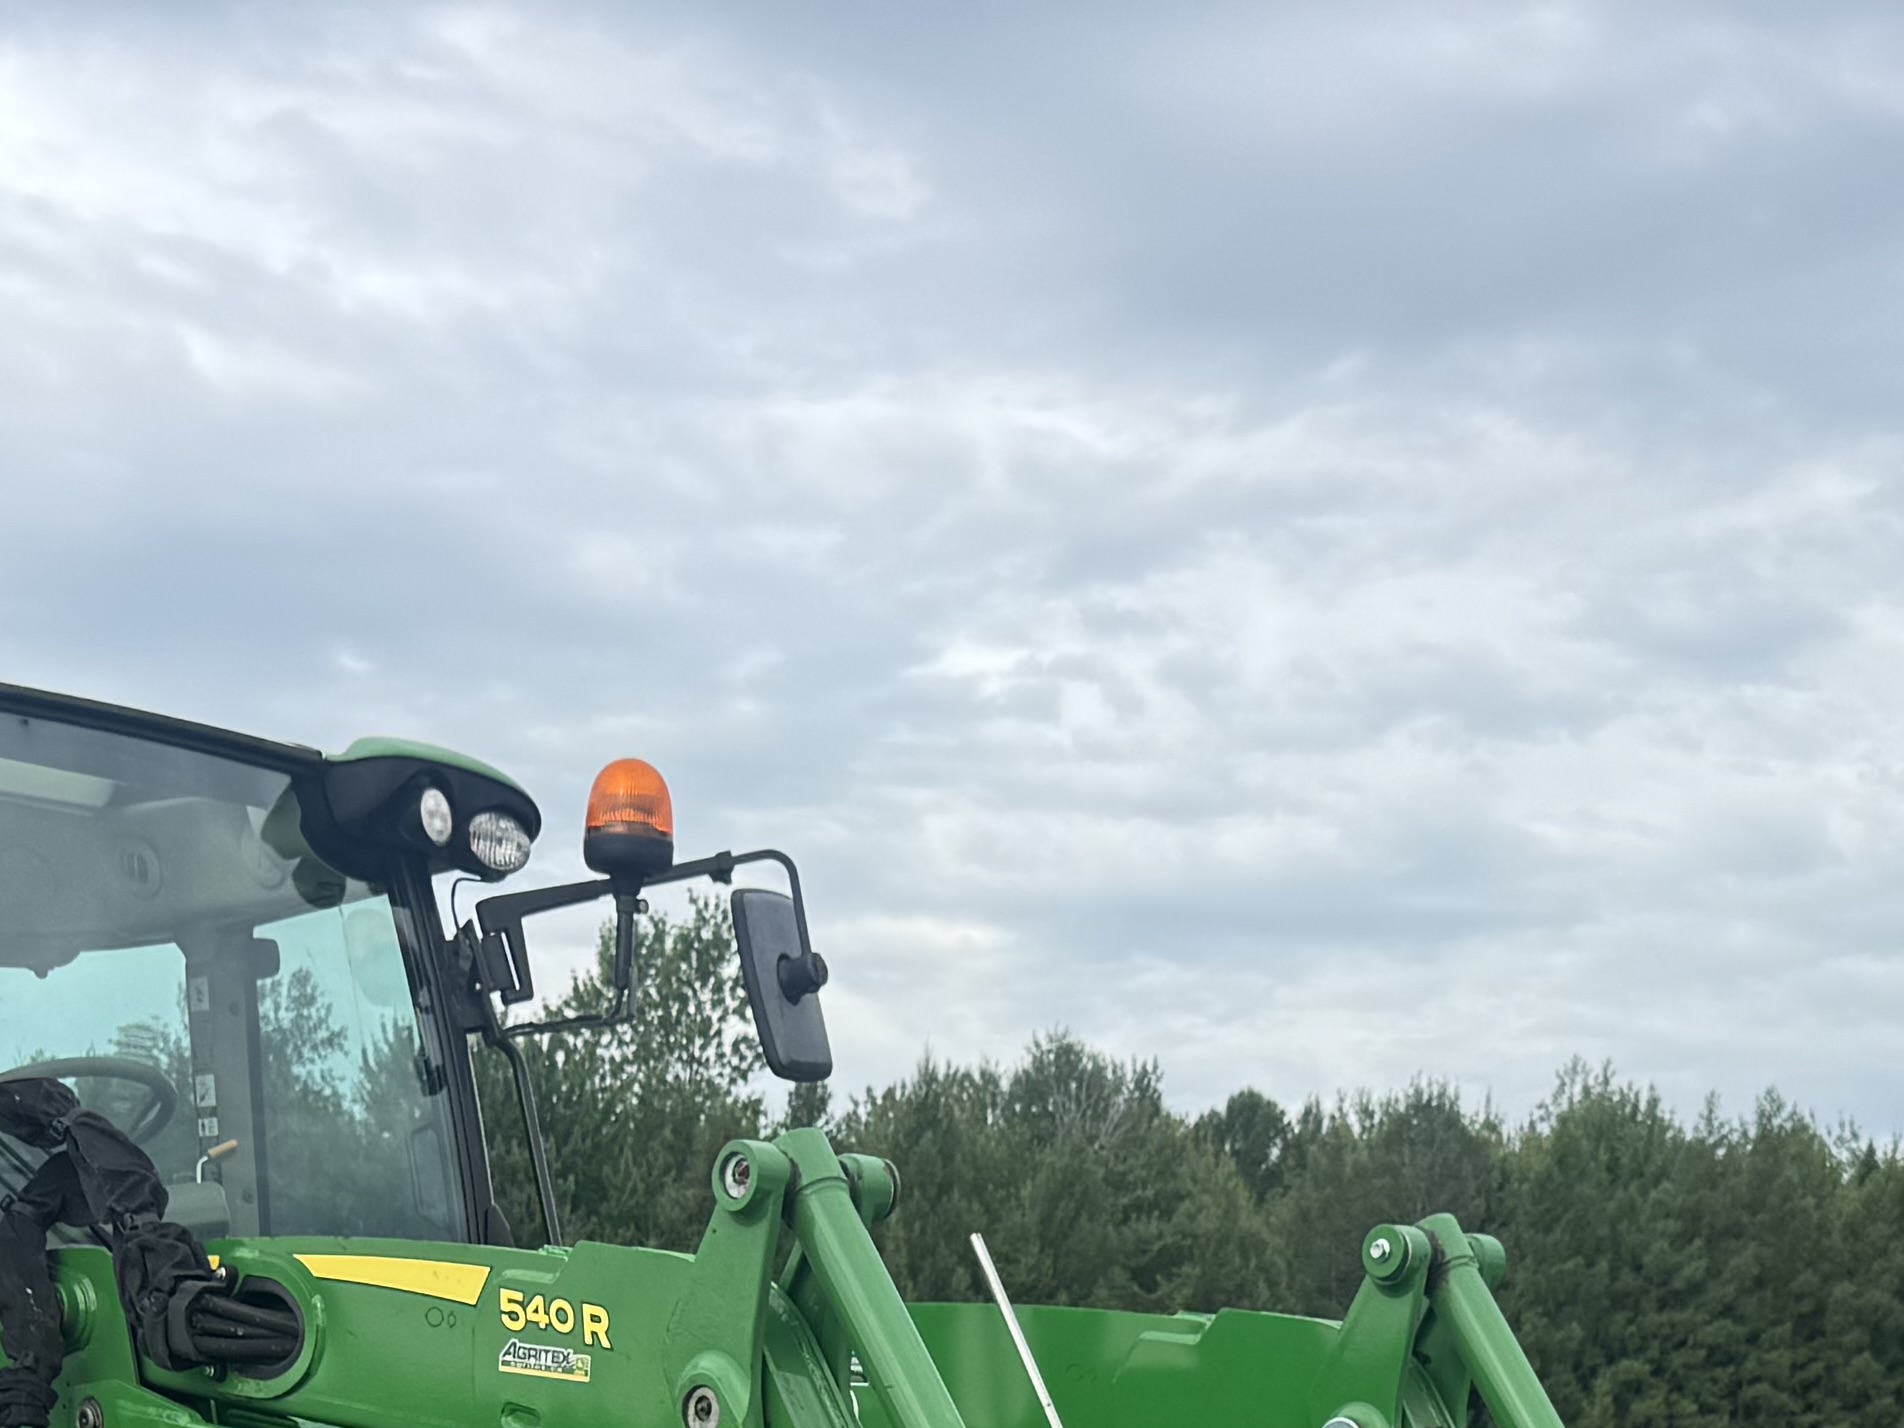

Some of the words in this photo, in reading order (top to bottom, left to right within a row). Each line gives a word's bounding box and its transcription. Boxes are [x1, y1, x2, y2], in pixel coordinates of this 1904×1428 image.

[500, 1287, 575, 1334] 540
[582, 1303, 612, 1349] R
[502, 1341, 573, 1366] AGRITEX
